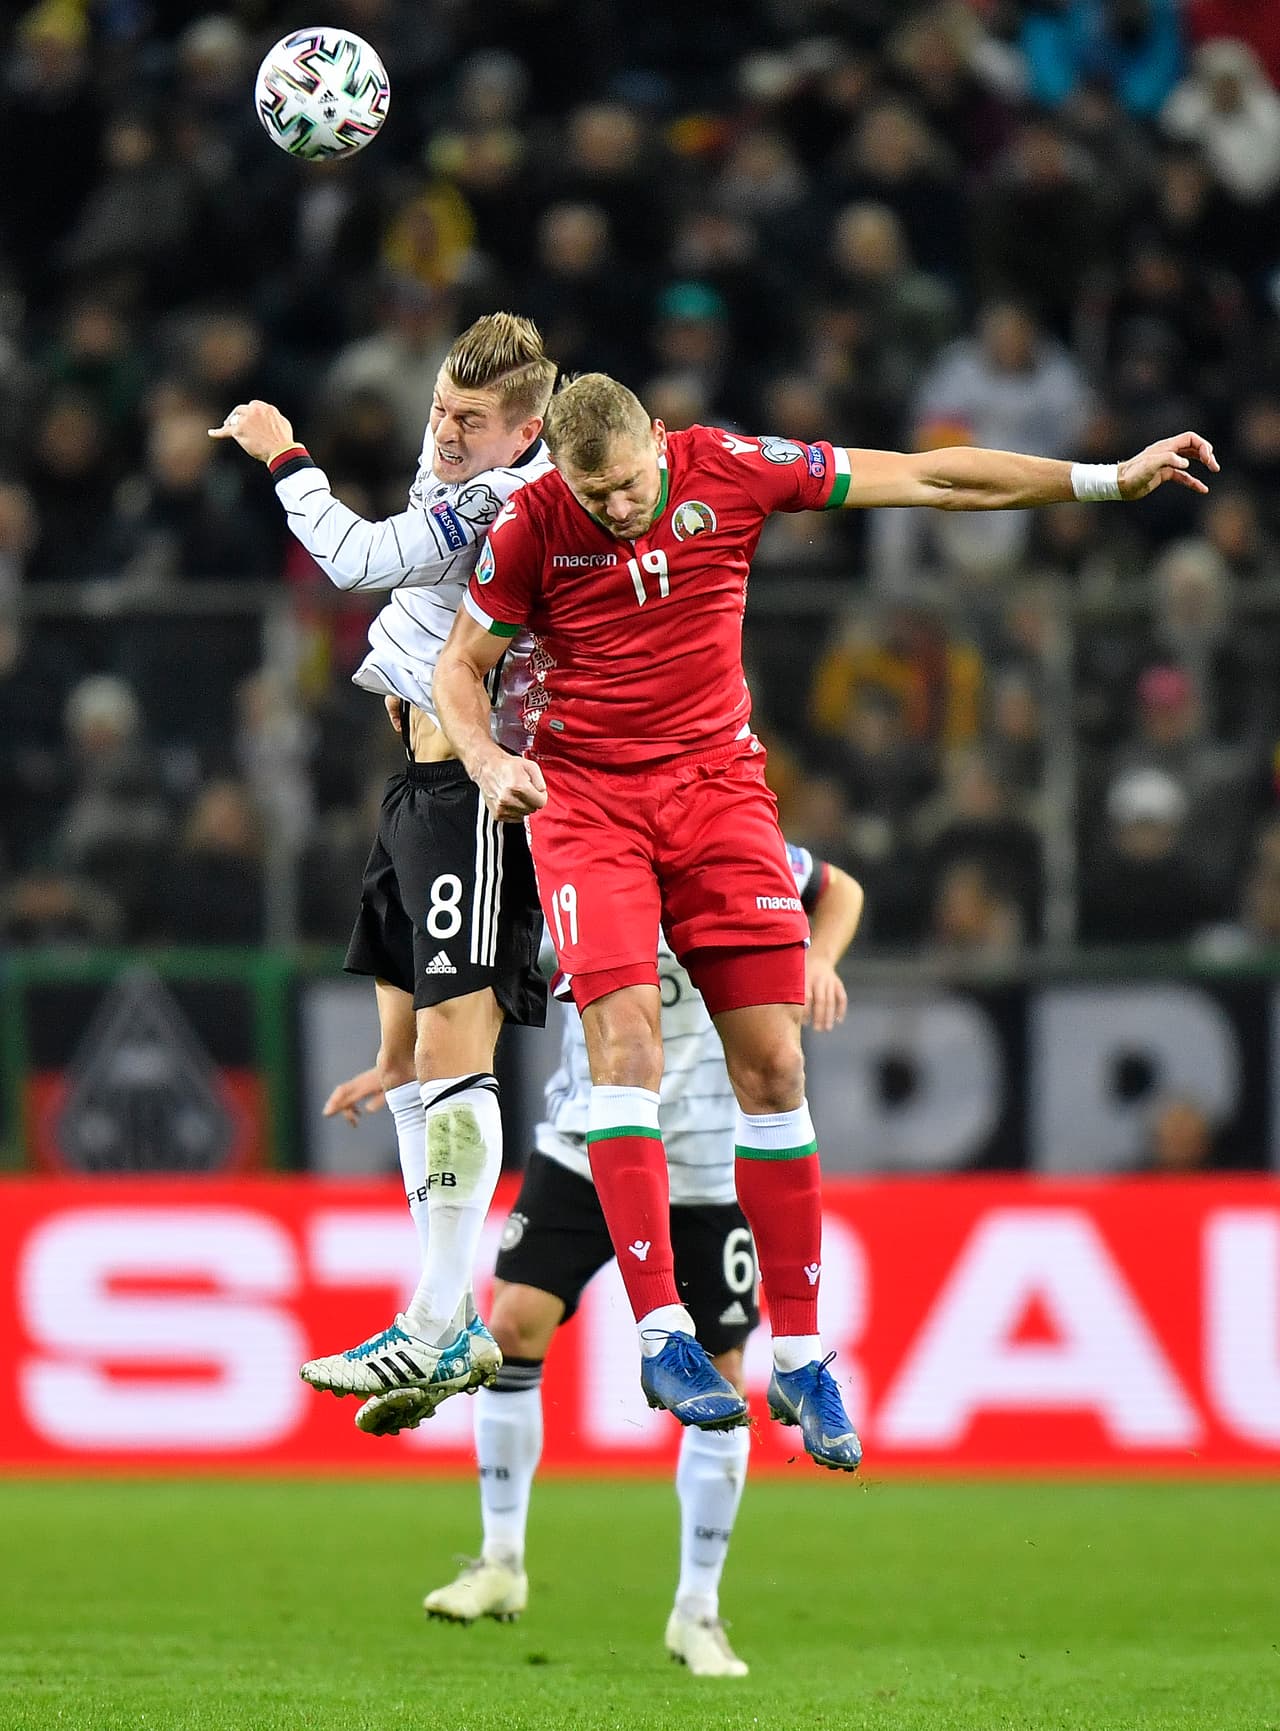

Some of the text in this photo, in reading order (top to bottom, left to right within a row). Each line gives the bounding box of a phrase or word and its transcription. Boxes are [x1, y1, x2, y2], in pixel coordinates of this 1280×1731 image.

[439, 511, 463, 548] RESPECT
[553, 553, 618, 568] macron
[626, 549, 670, 607] 19
[426, 873, 463, 939] 8
[552, 883, 579, 951] 19
[425, 965, 458, 975] adidas
[723, 1227, 754, 1294] 6
